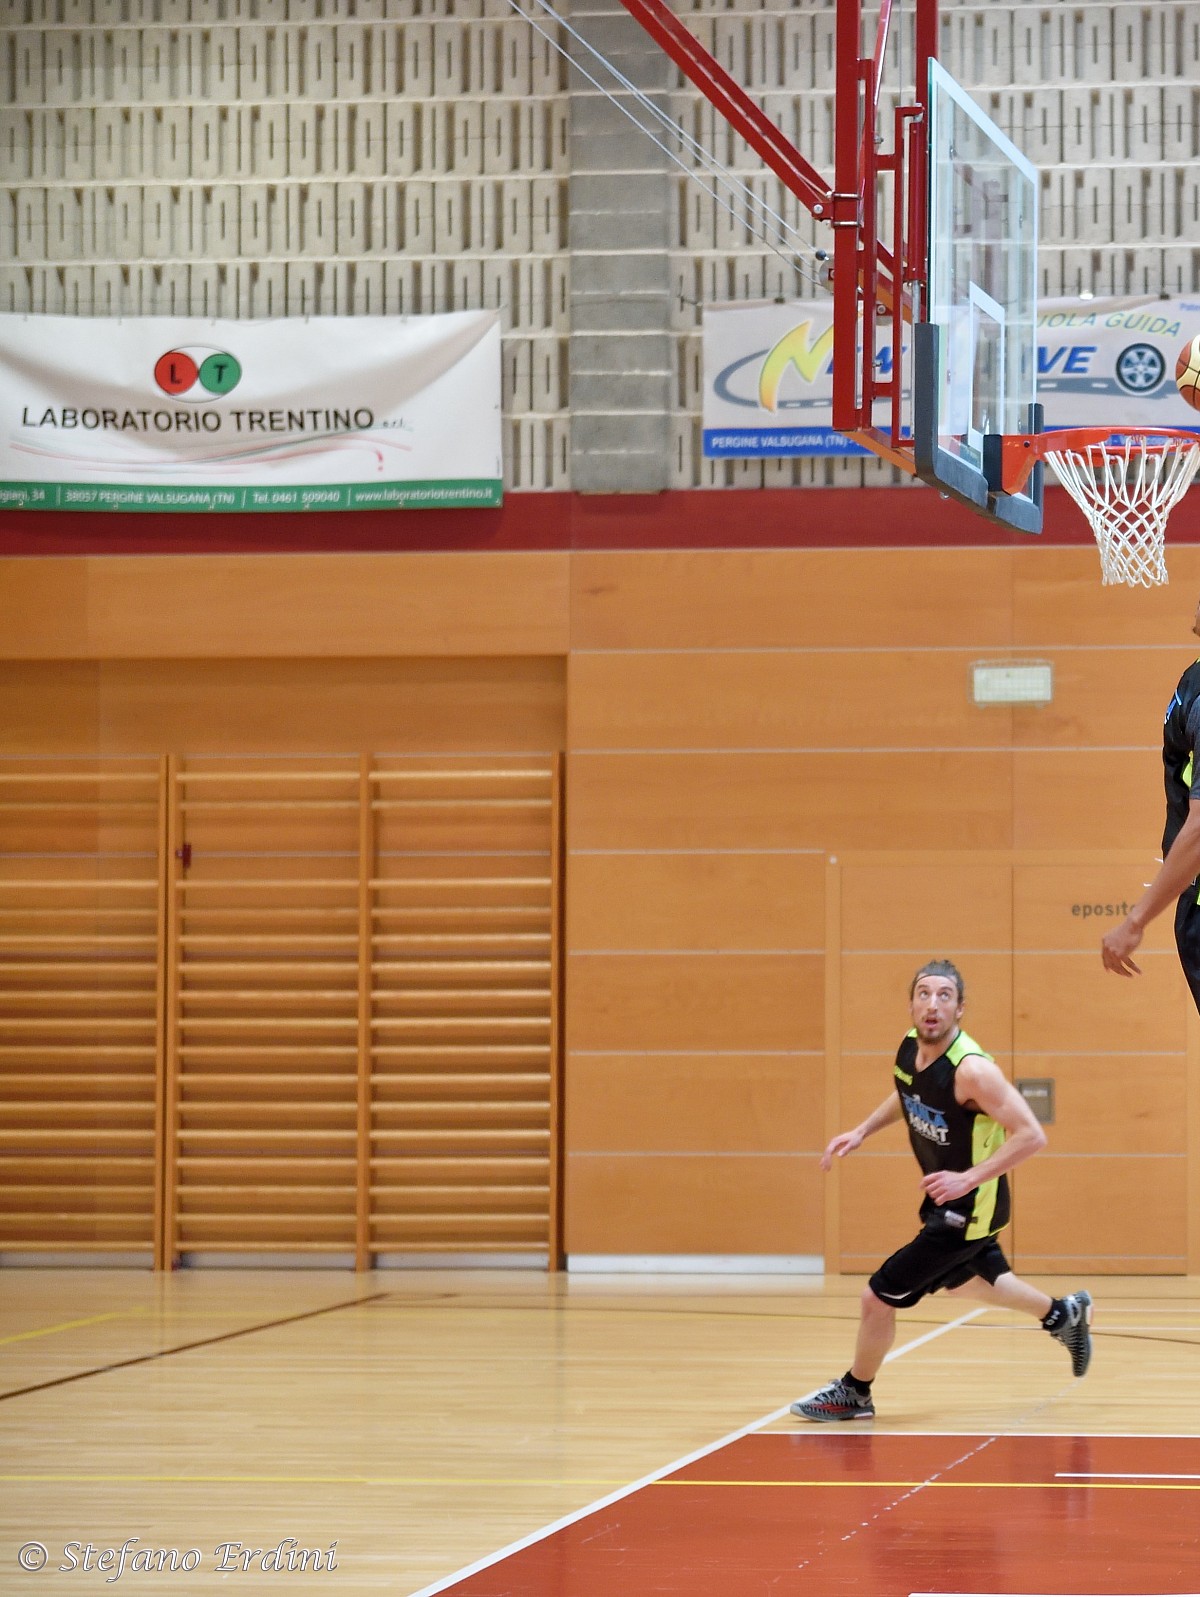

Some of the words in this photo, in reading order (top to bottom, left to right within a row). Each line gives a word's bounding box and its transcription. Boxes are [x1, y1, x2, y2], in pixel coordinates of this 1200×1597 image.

[1105, 312, 1181, 336] GUIDA
[21, 406, 222, 433] LABORATORIO
[230, 407, 375, 433] TRENTINO
[712, 434, 759, 448] PERGINE
[761, 434, 823, 448] VALSUGANA
[825, 434, 849, 448] (TN)
[98, 490, 144, 504] PERGINE
[146, 491, 210, 505] VALSUGANA
[355, 487, 493, 502] www.laboratoriotrentino.it
